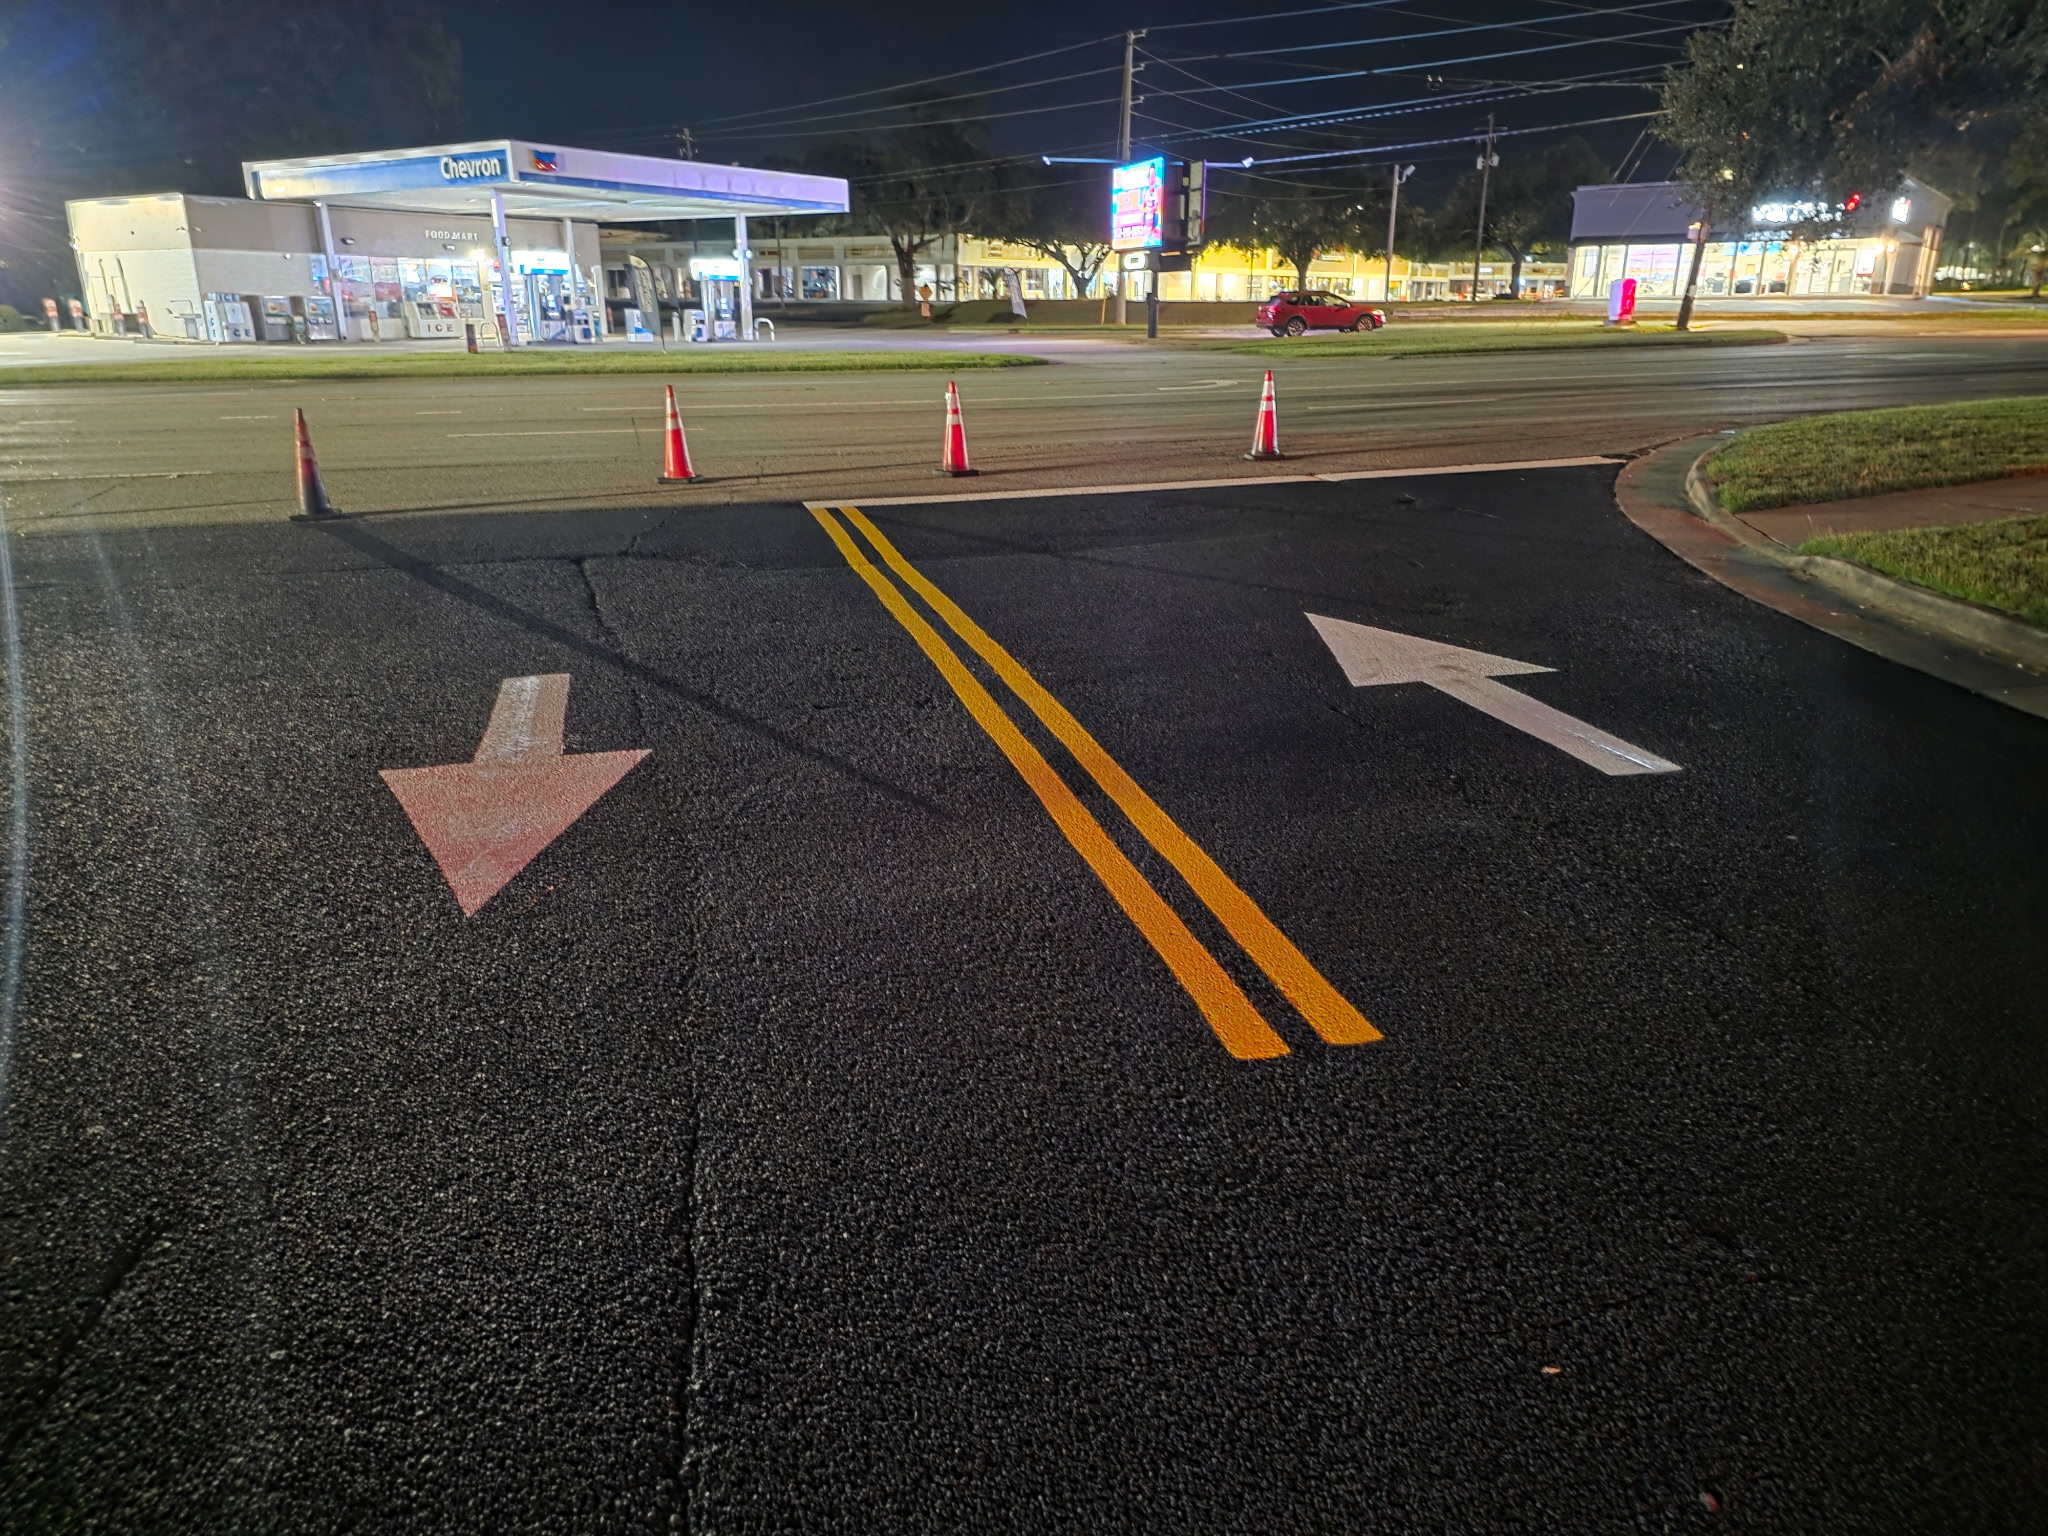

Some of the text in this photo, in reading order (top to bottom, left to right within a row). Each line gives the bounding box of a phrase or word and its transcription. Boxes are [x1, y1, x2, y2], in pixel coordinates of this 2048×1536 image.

[441, 157, 500, 180] Chevron
[425, 230, 478, 240] FOOD MART
[427, 323, 454, 333] ICE
